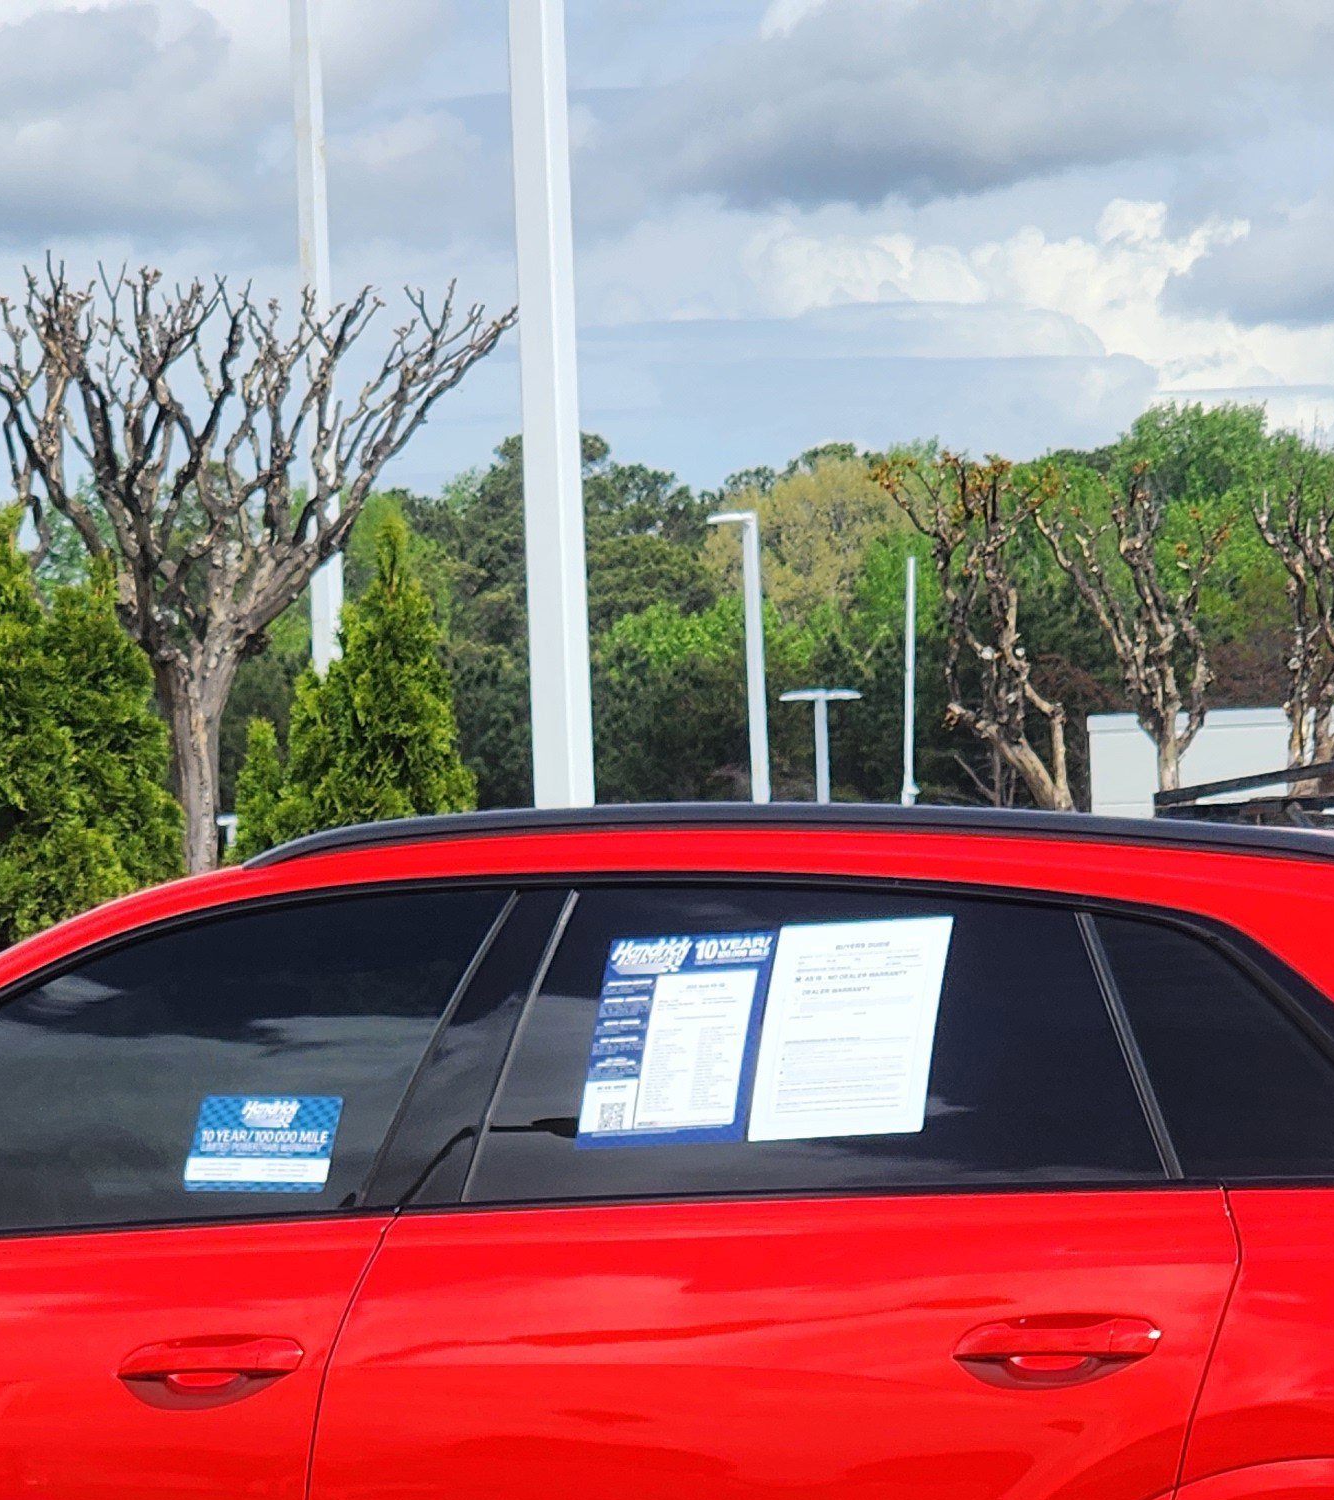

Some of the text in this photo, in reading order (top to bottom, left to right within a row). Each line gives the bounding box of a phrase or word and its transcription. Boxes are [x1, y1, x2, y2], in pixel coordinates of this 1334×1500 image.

[695, 939, 718, 960] 10
[201, 1129, 215, 1142] 10
[299, 1131, 329, 1143] MILE
